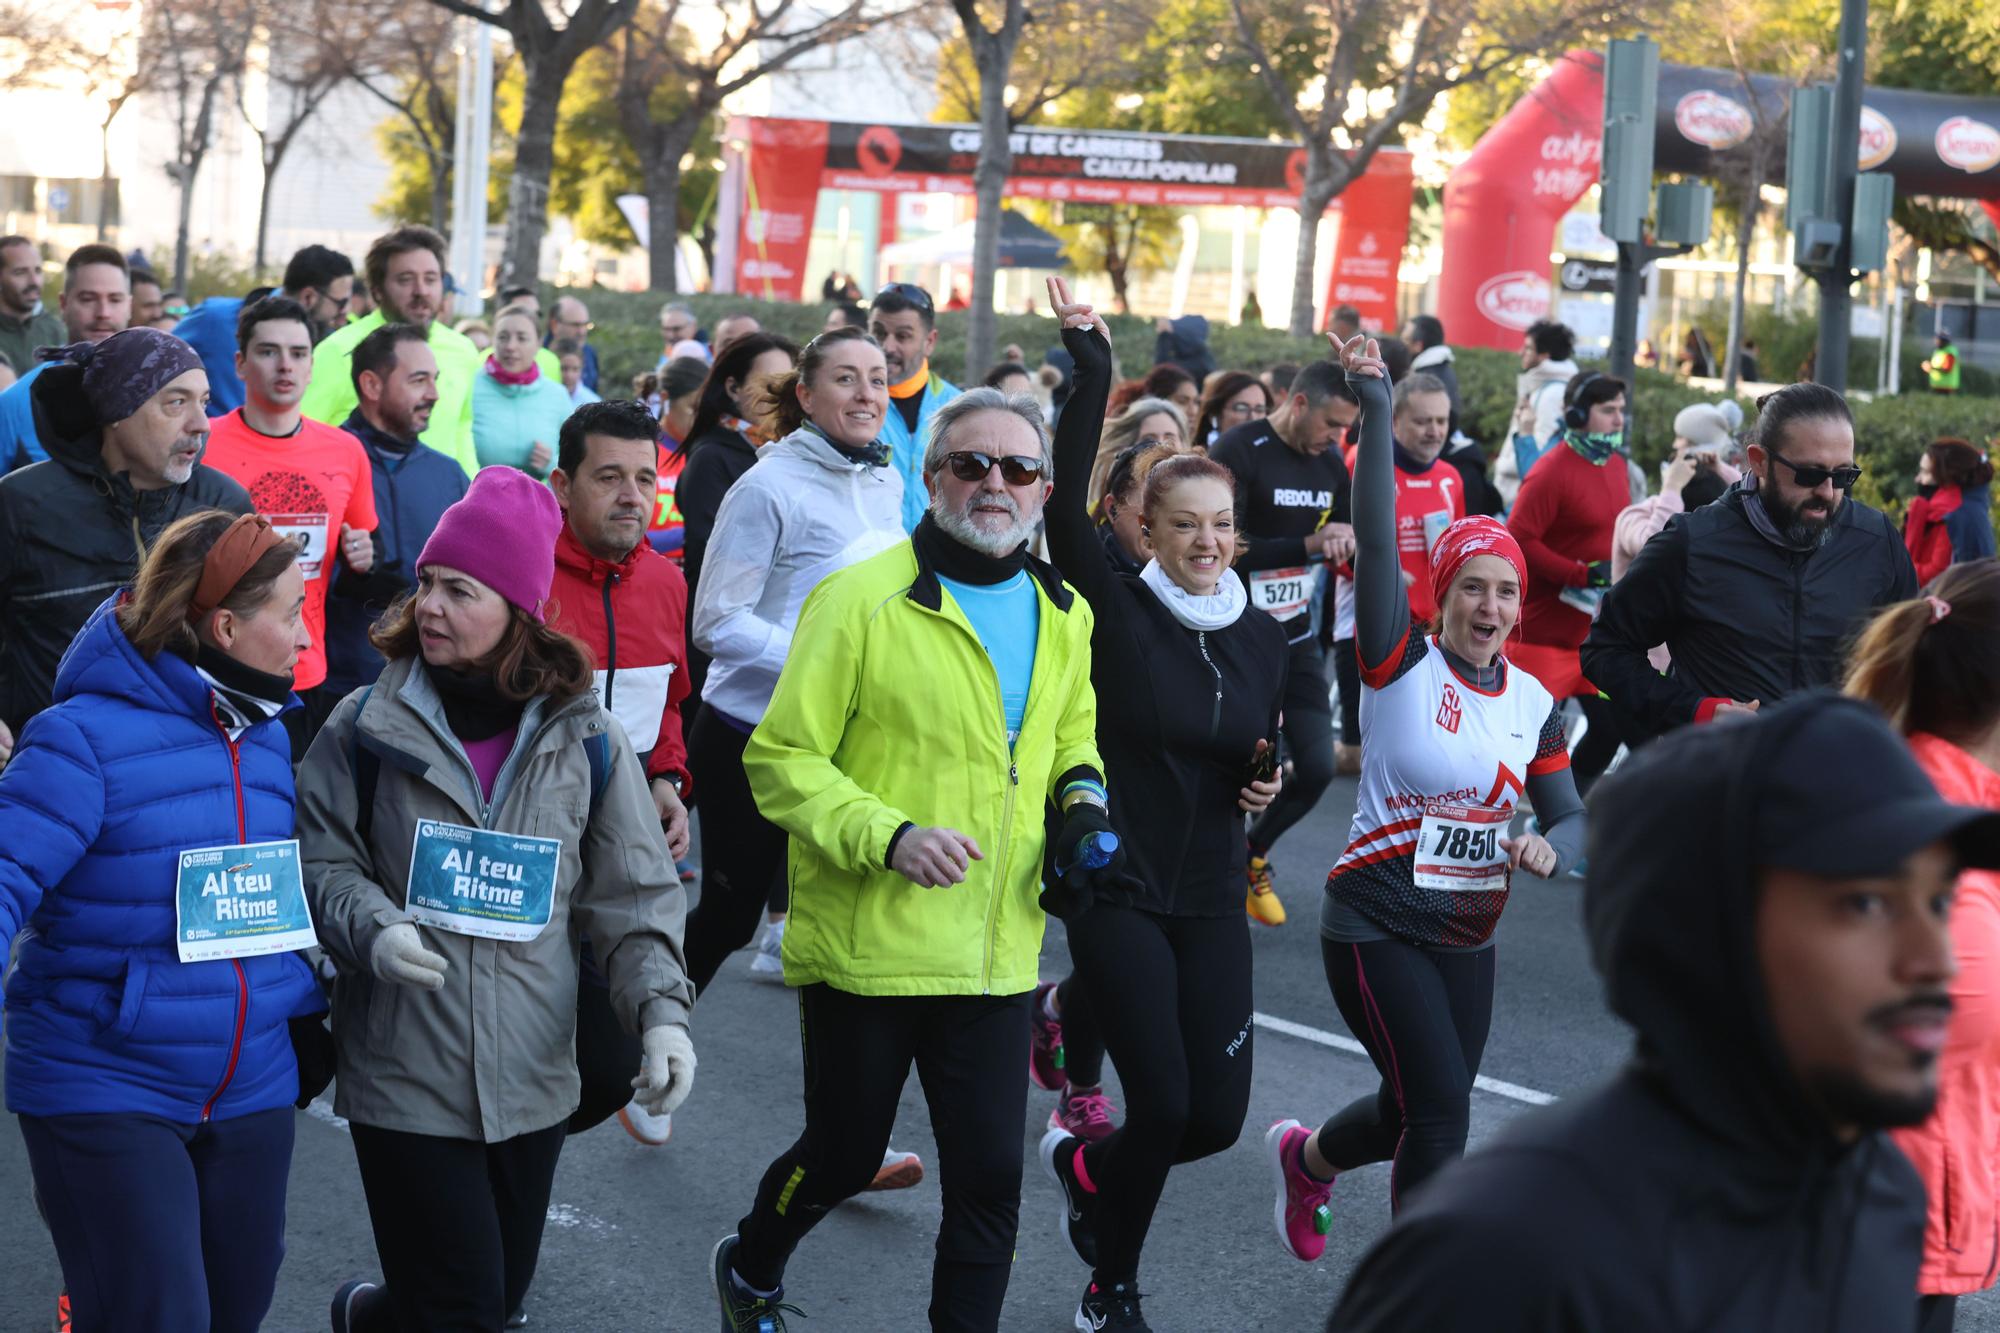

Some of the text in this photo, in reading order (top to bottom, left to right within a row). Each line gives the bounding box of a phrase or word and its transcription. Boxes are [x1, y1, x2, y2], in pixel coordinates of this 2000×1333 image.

[950, 131, 1163, 161] CIRIT DE CARRERES
[1083, 157, 1237, 184] CAIXAPOPULAR
[1264, 580, 1302, 604] 5271
[1433, 825, 1497, 862] 7850
[441, 848, 523, 882] Al teu
[201, 870, 272, 897] Al teu
[453, 875, 524, 905] Ritme
[215, 897, 279, 921] Ritme
[1225, 1031, 1247, 1057] FILA
